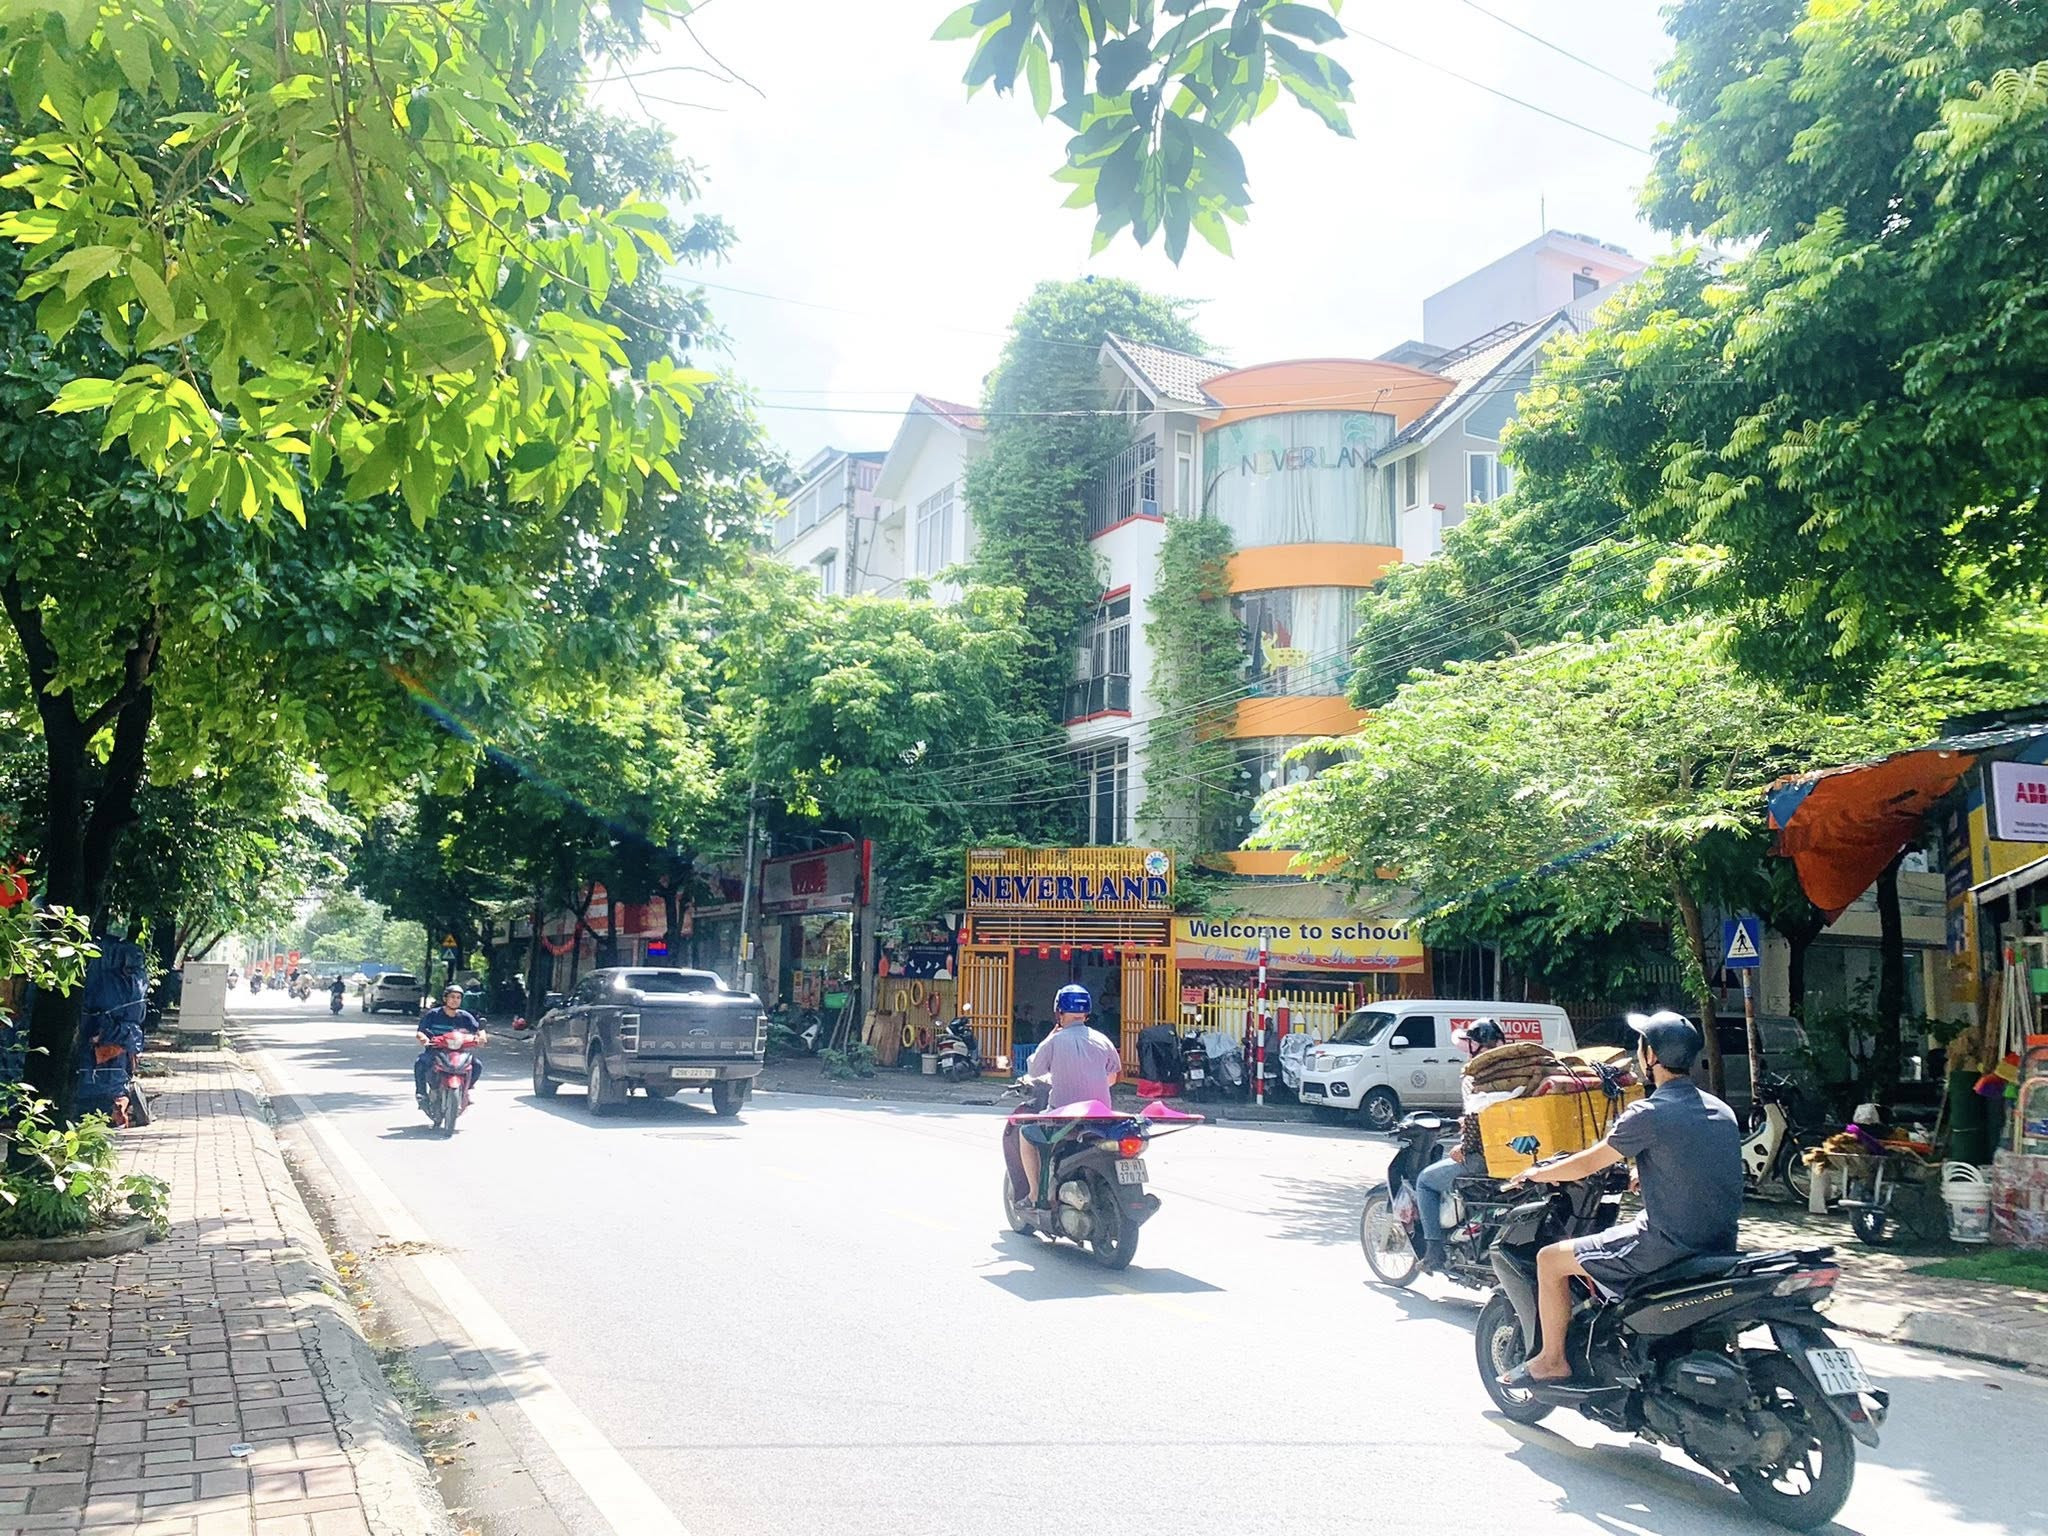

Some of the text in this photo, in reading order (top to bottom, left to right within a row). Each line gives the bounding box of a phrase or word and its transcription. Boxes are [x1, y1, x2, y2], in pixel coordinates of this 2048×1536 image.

[971, 875, 1168, 900] NEVERLAND
[1189, 920, 1409, 939] Welcome to school
[641, 1041, 753, 1049] RANGER
